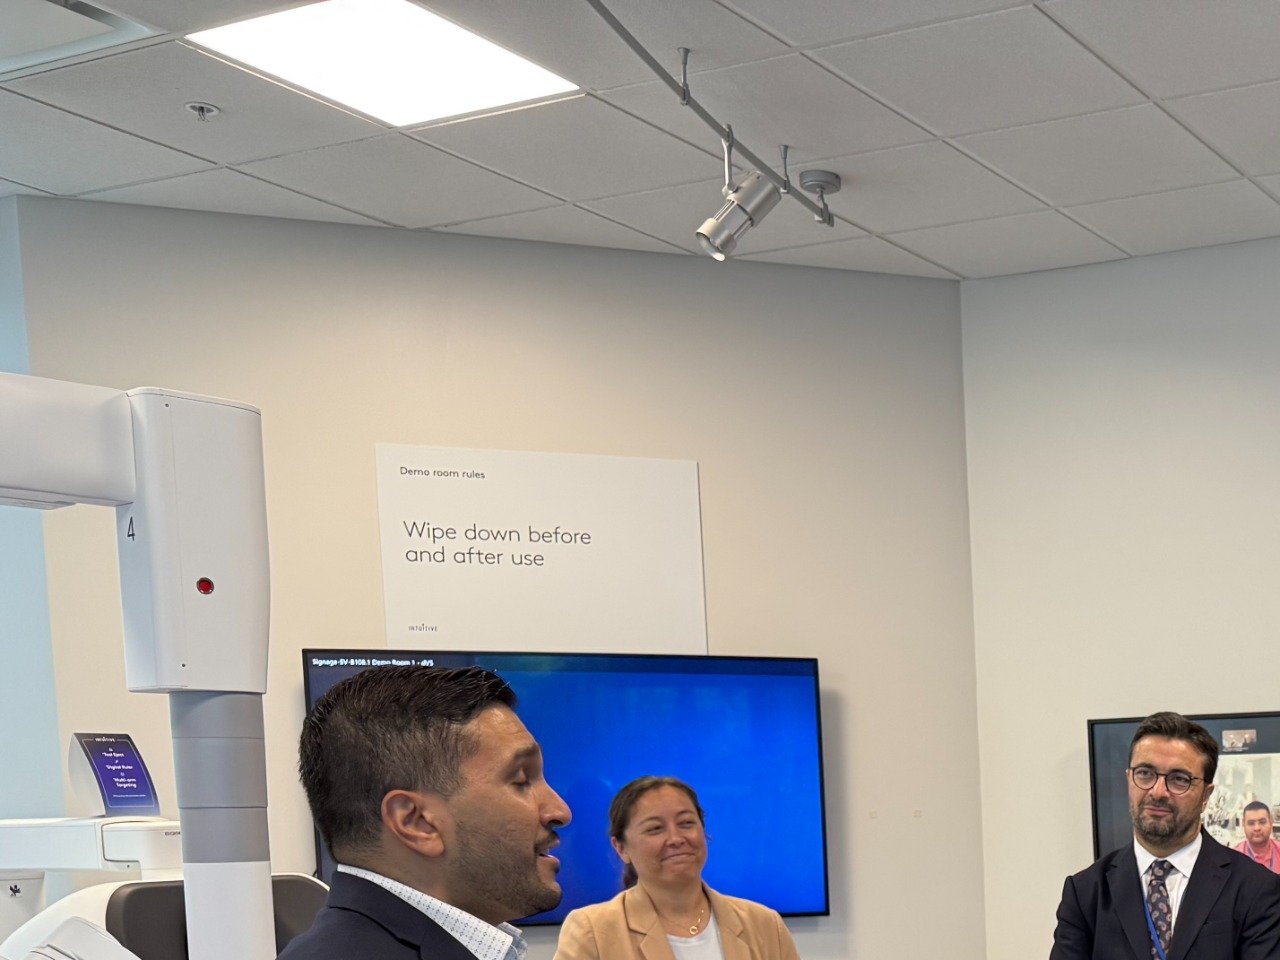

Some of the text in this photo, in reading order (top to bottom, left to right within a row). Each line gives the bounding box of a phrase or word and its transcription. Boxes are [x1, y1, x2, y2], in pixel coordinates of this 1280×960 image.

[400, 466, 486, 479] Demo room rules
[127, 516, 135, 541] 4
[403, 520, 592, 545] Wipe down before
[405, 546, 545, 566] and after use
[408, 623, 438, 632] INTUITIVE
